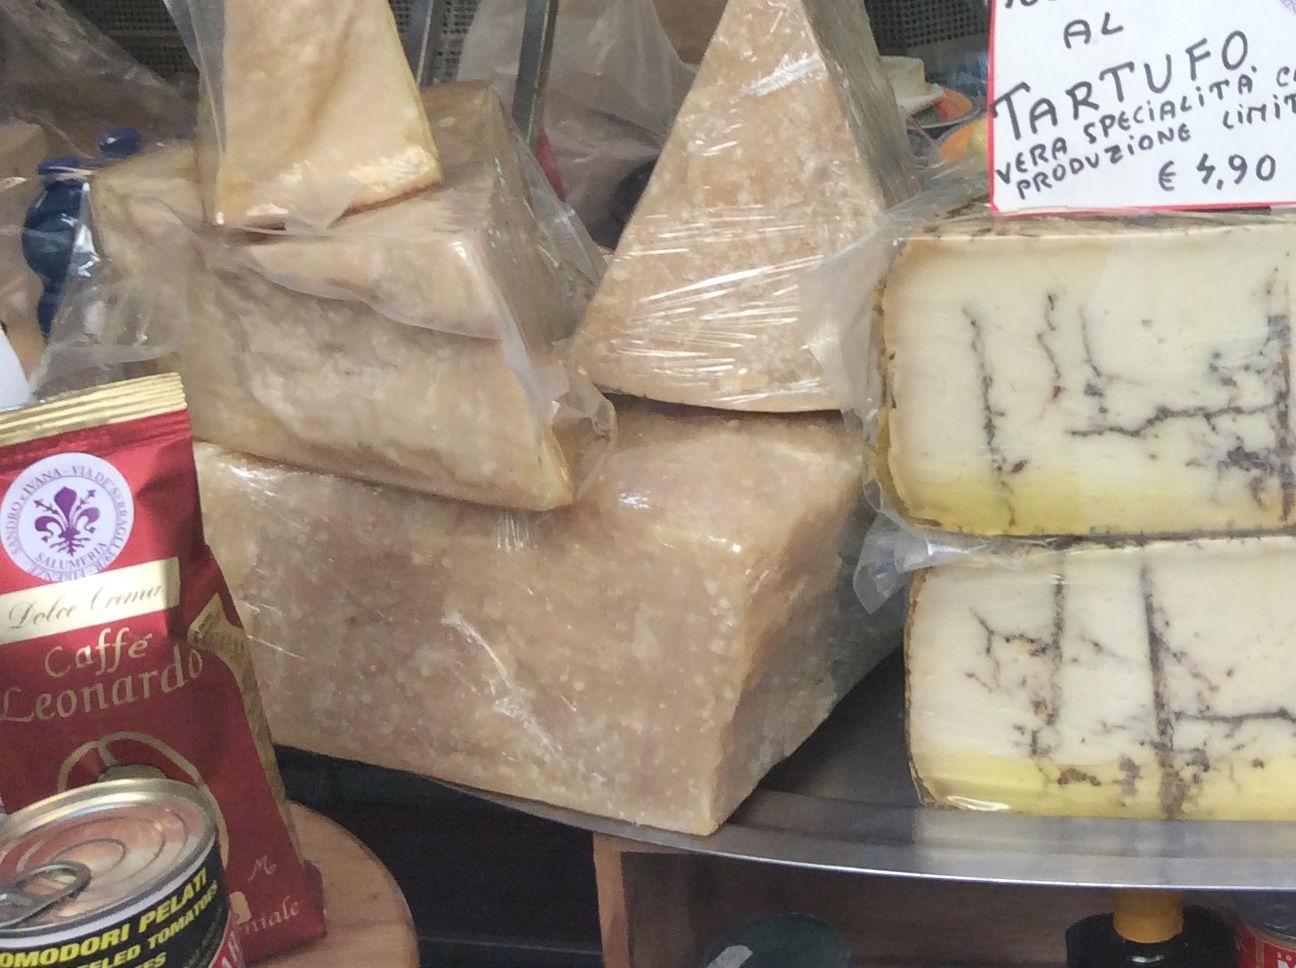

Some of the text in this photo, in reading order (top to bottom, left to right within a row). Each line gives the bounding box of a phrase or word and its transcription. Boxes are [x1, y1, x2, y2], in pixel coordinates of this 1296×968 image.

[1063, 13, 1124, 48] AL
[992, 30, 1249, 140] TARTUFO
[996, 137, 1067, 185] VERA
[1017, 124, 1191, 199] PRODUZIONE
[1158, 160, 1176, 192] €
[1196, 153, 1277, 190] 4,90
[8, 597, 77, 629] Dolce
[0, 643, 203, 723] Leonardo
[0, 923, 129, 967] OMODORI
[138, 866, 206, 934] PELATI
